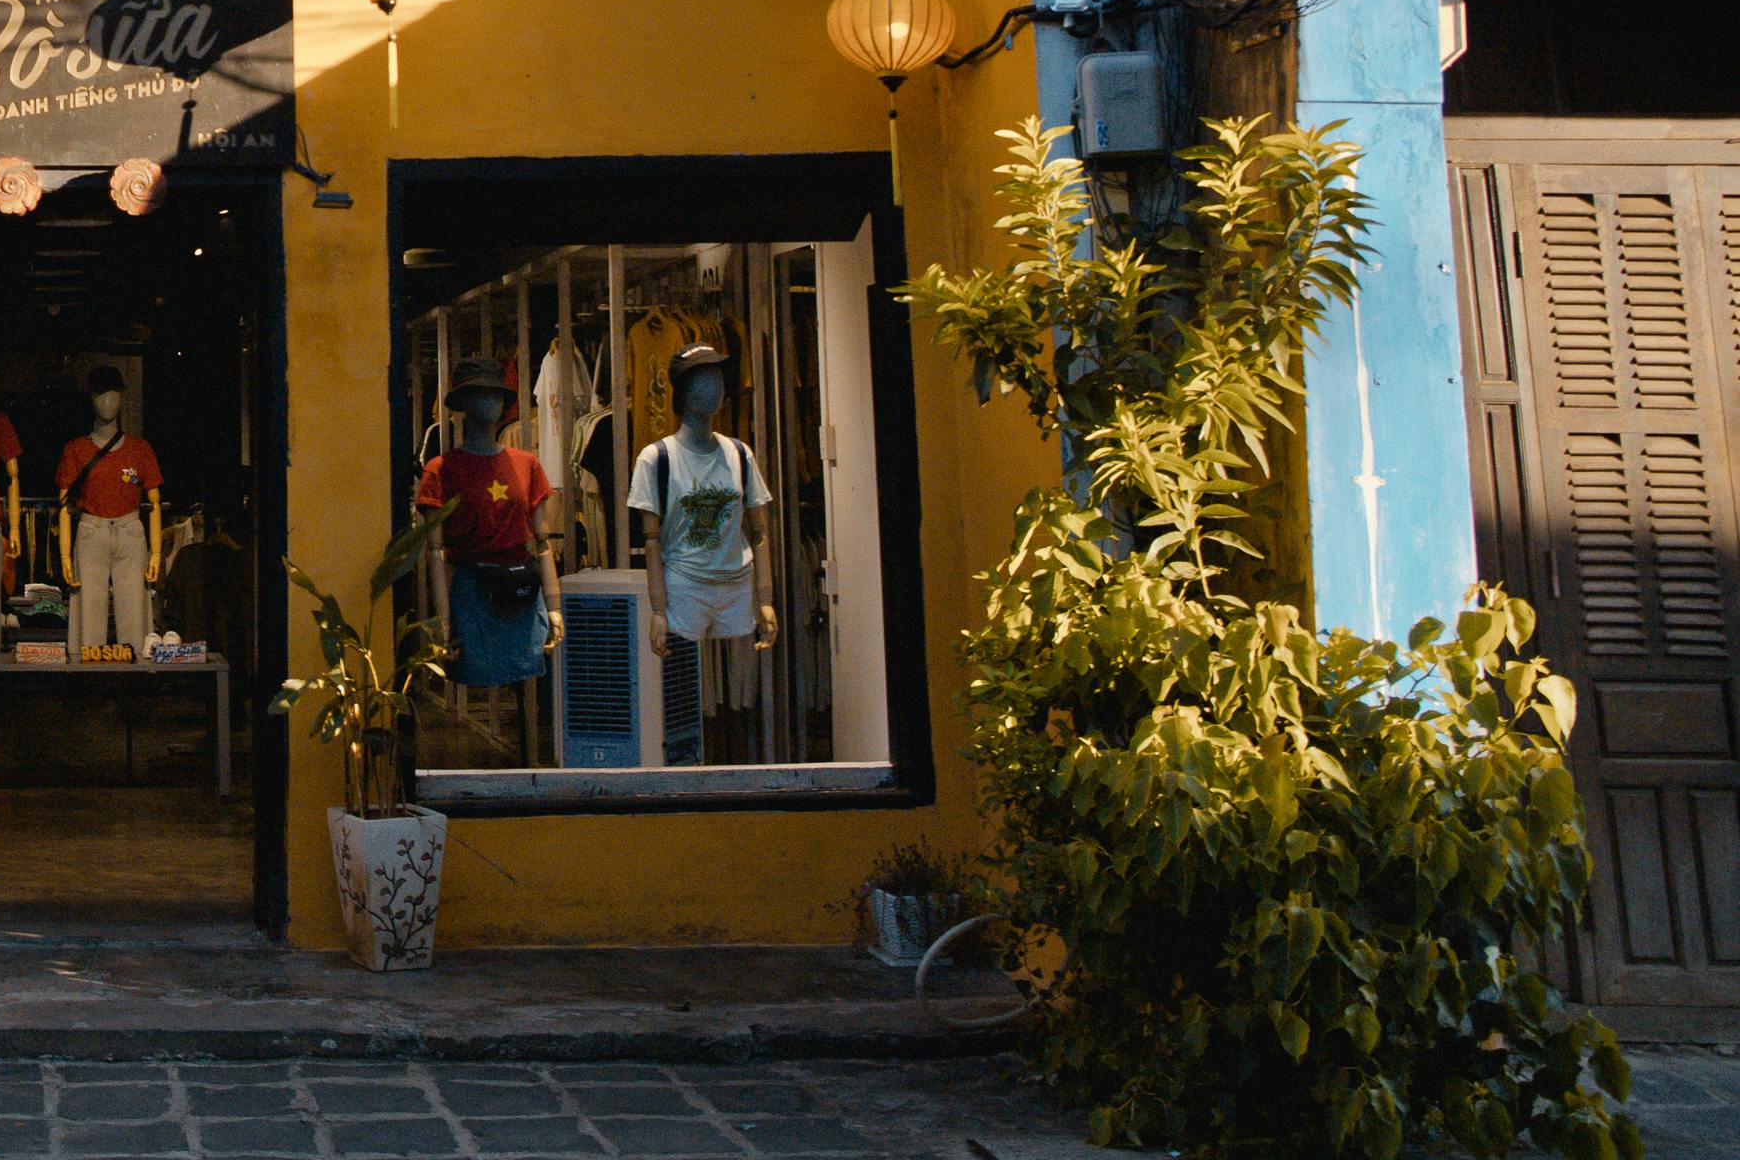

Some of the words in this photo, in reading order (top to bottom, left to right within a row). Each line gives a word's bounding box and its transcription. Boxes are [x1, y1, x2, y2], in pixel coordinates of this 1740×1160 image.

[55, 84, 119, 112] TIẾNG
[123, 70, 166, 101] THỦ
[197, 127, 237, 154] HỘI
[241, 132, 276, 149] AN
